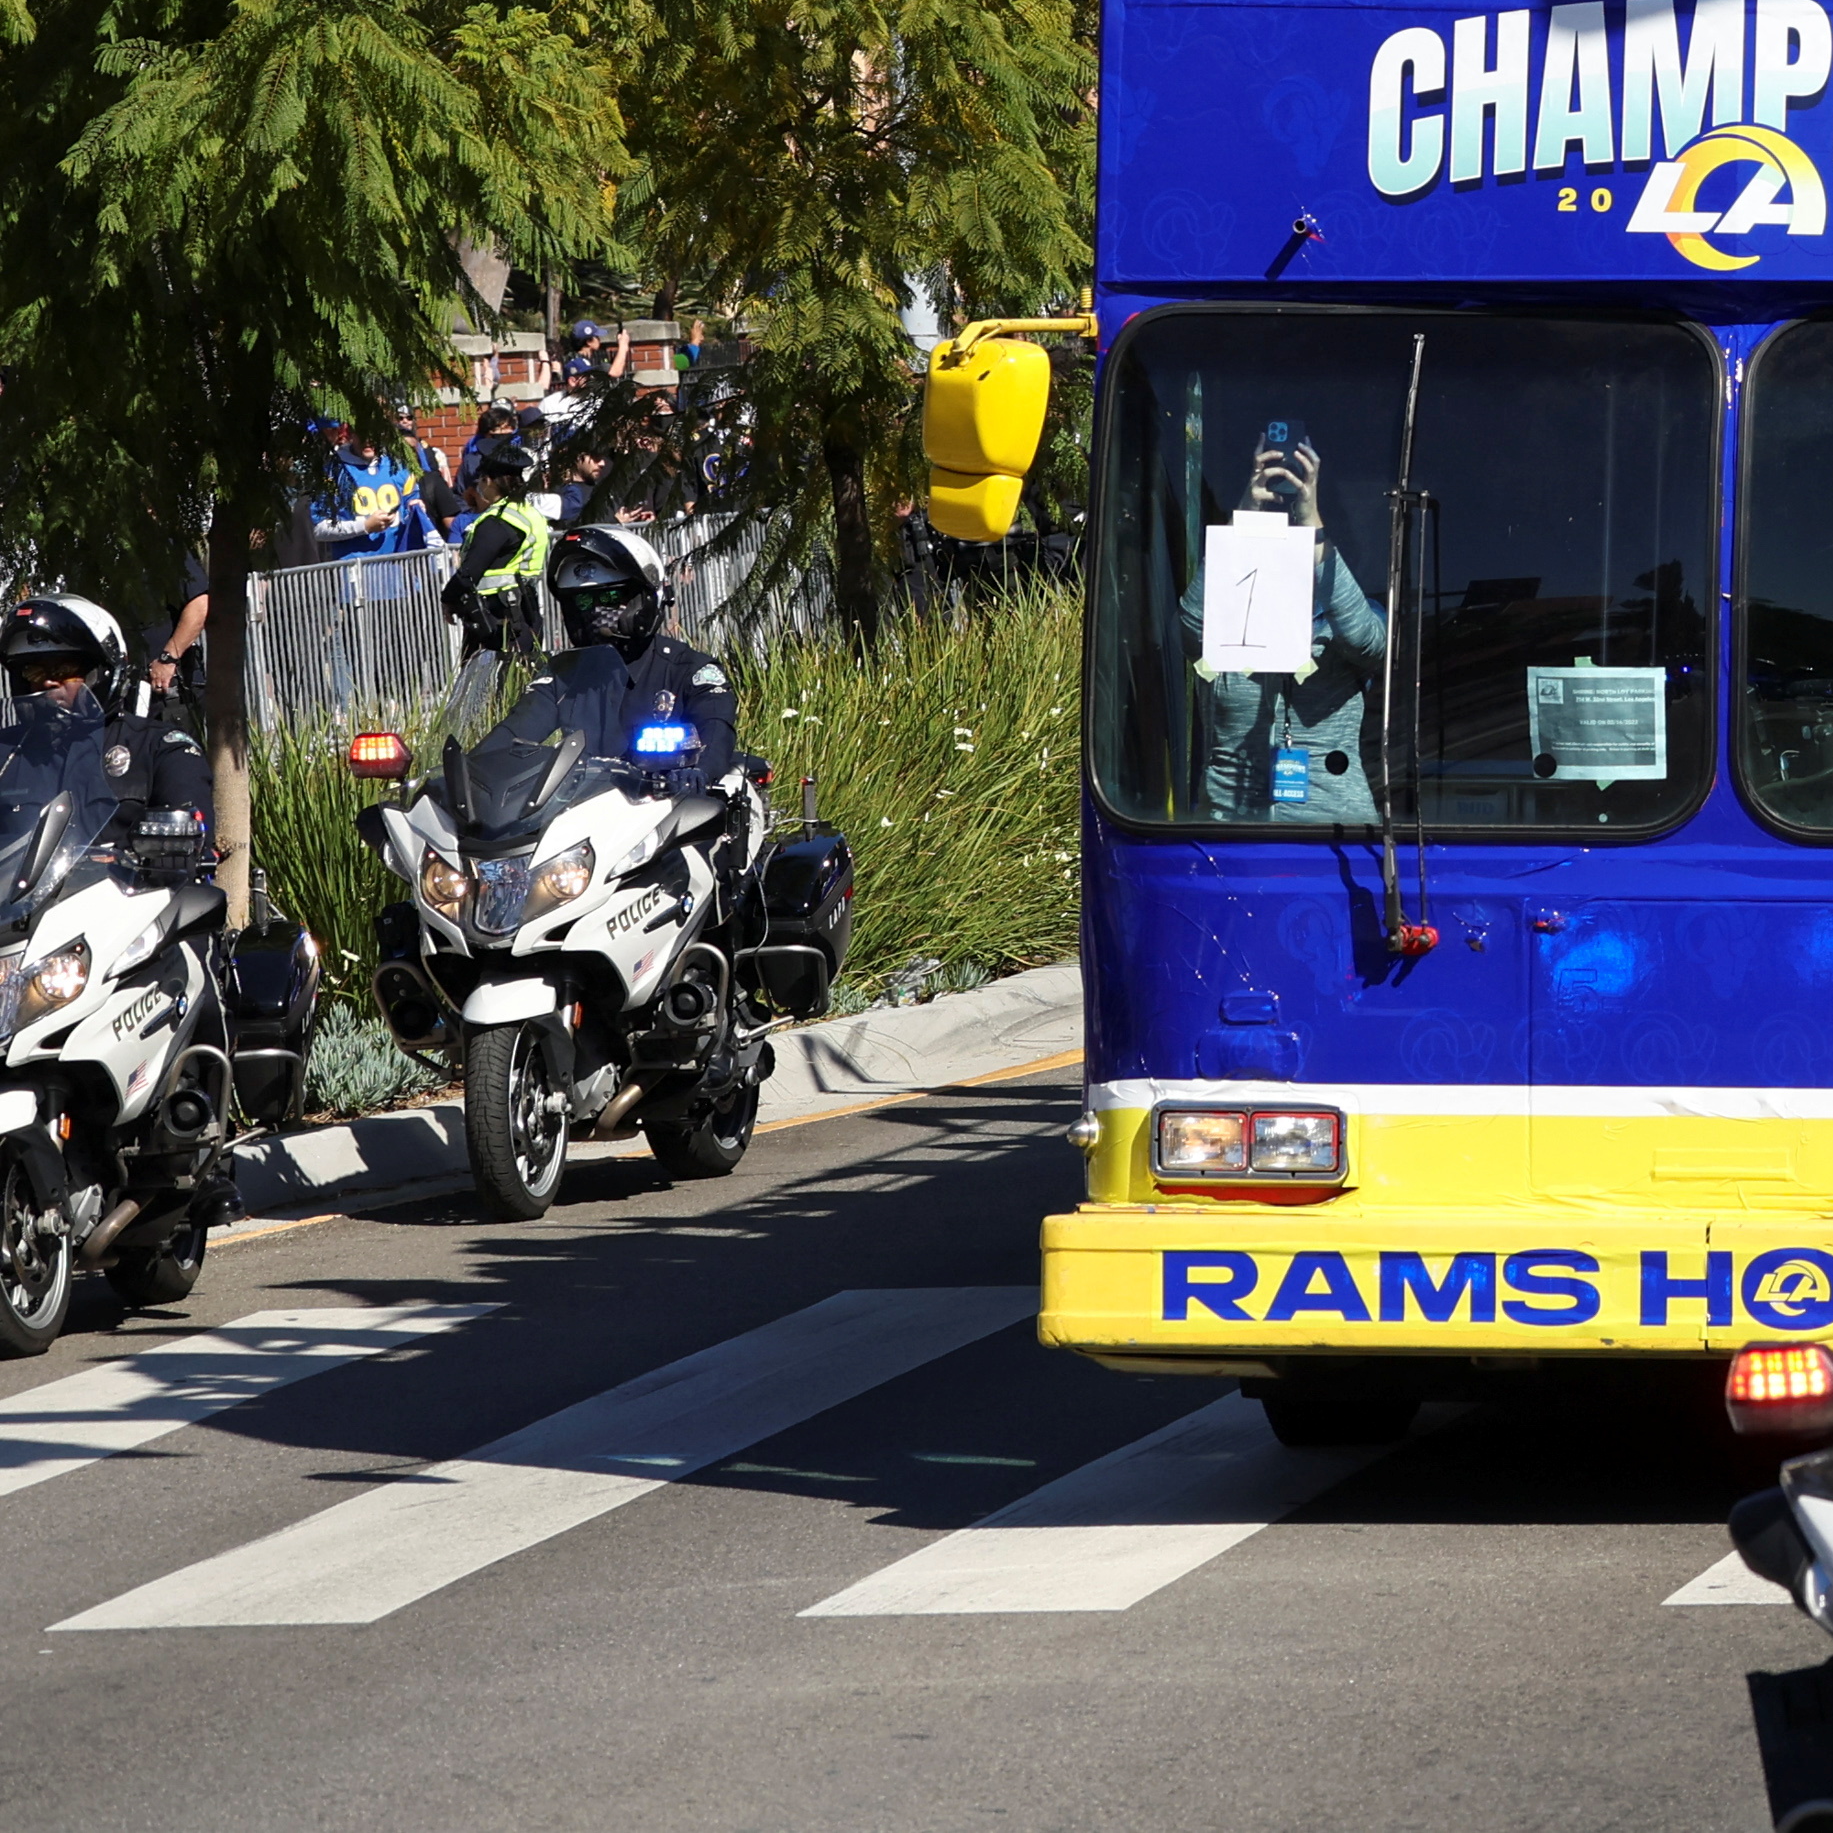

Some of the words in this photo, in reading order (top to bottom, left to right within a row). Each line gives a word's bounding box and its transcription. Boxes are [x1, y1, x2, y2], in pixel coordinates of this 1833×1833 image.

[1556, 186, 1613, 213] 20
[1219, 567, 1268, 649] 1
[606, 886, 662, 941] POLICE
[112, 986, 162, 1042] POLICE
[1161, 1247, 1600, 1328] RAMS
